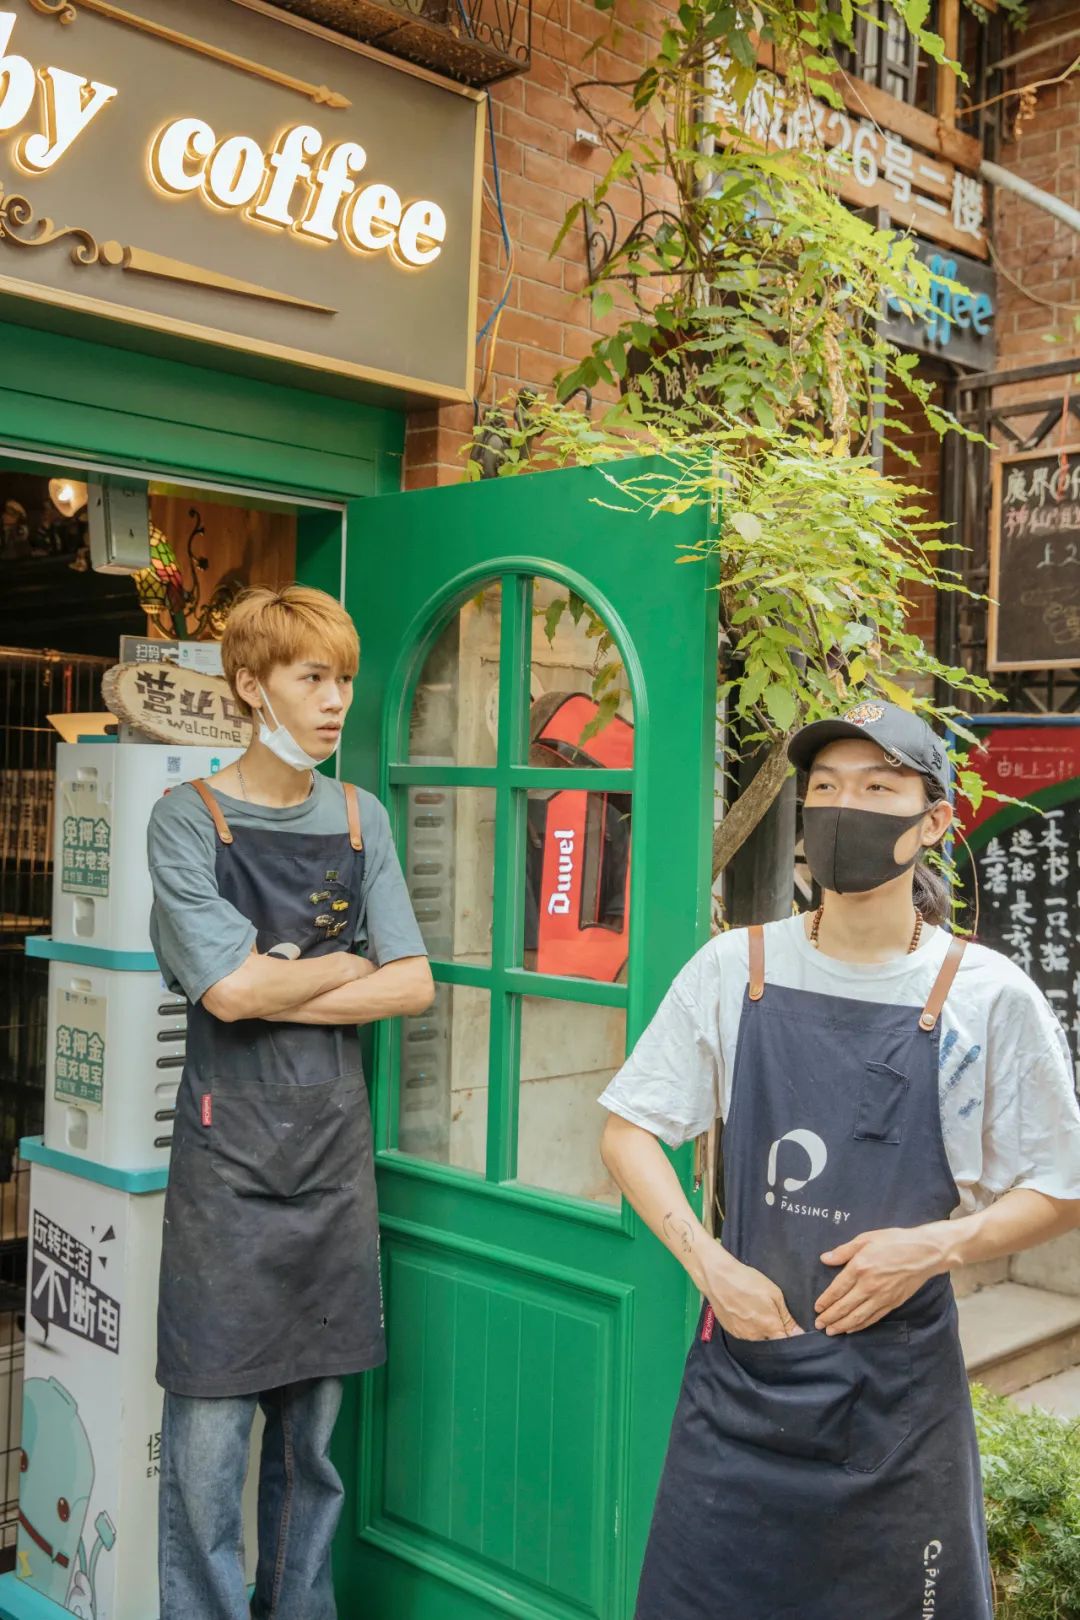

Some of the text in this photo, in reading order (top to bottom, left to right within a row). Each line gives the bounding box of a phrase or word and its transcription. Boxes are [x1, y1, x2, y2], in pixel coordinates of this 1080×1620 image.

[150, 117, 447, 268] coffee
[63, 819, 110, 849] 免押金
[547, 829, 576, 916] Duvel
[57, 1027, 104, 1064] 免押金
[780, 1196, 851, 1225] PASSING BY
[34, 1213, 91, 1280] 玩转生活
[32, 1248, 119, 1350] 不断电
